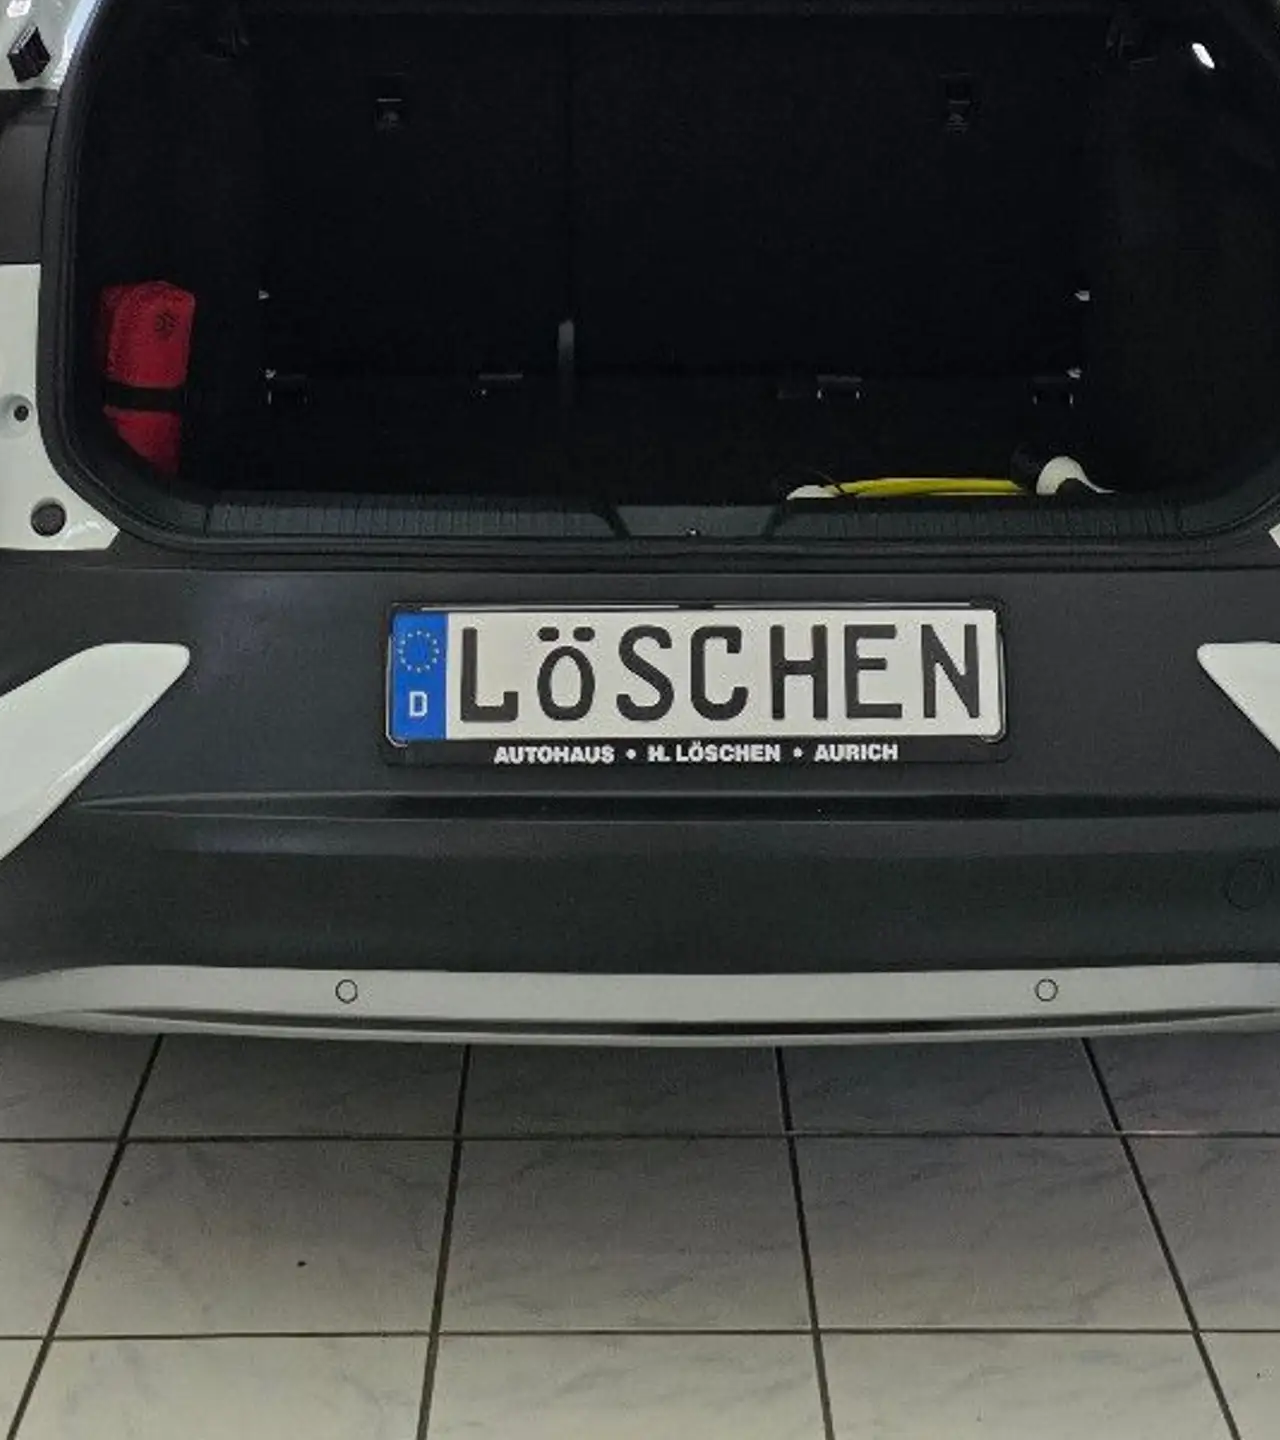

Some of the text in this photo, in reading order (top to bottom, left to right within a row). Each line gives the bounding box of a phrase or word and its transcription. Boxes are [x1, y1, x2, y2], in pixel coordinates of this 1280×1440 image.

[409, 691, 427, 717] D
[494, 746, 616, 764] AUTOHAUS
[676, 741, 781, 763] LÖSCHEN
[814, 744, 899, 762] AURICH
